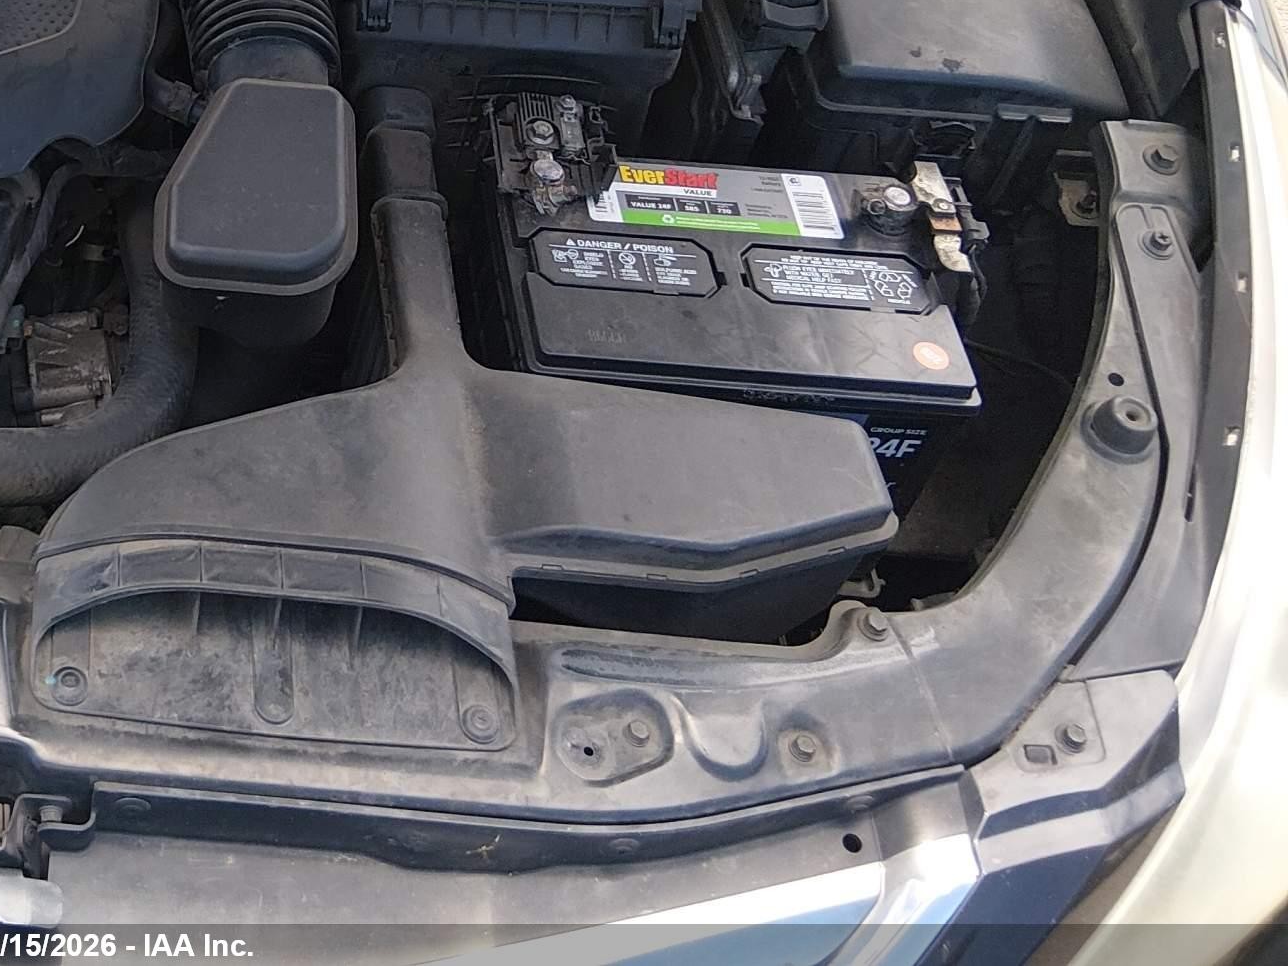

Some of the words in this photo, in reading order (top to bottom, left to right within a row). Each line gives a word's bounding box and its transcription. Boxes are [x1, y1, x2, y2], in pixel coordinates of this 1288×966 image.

[619, 165, 718, 190] EverStart
[683, 188, 712, 197] VALUE
[630, 201, 656, 210] VALUE
[577, 239, 622, 250] DANGER
[633, 243, 673, 254] POISON
[870, 426, 904, 434] GROUP
